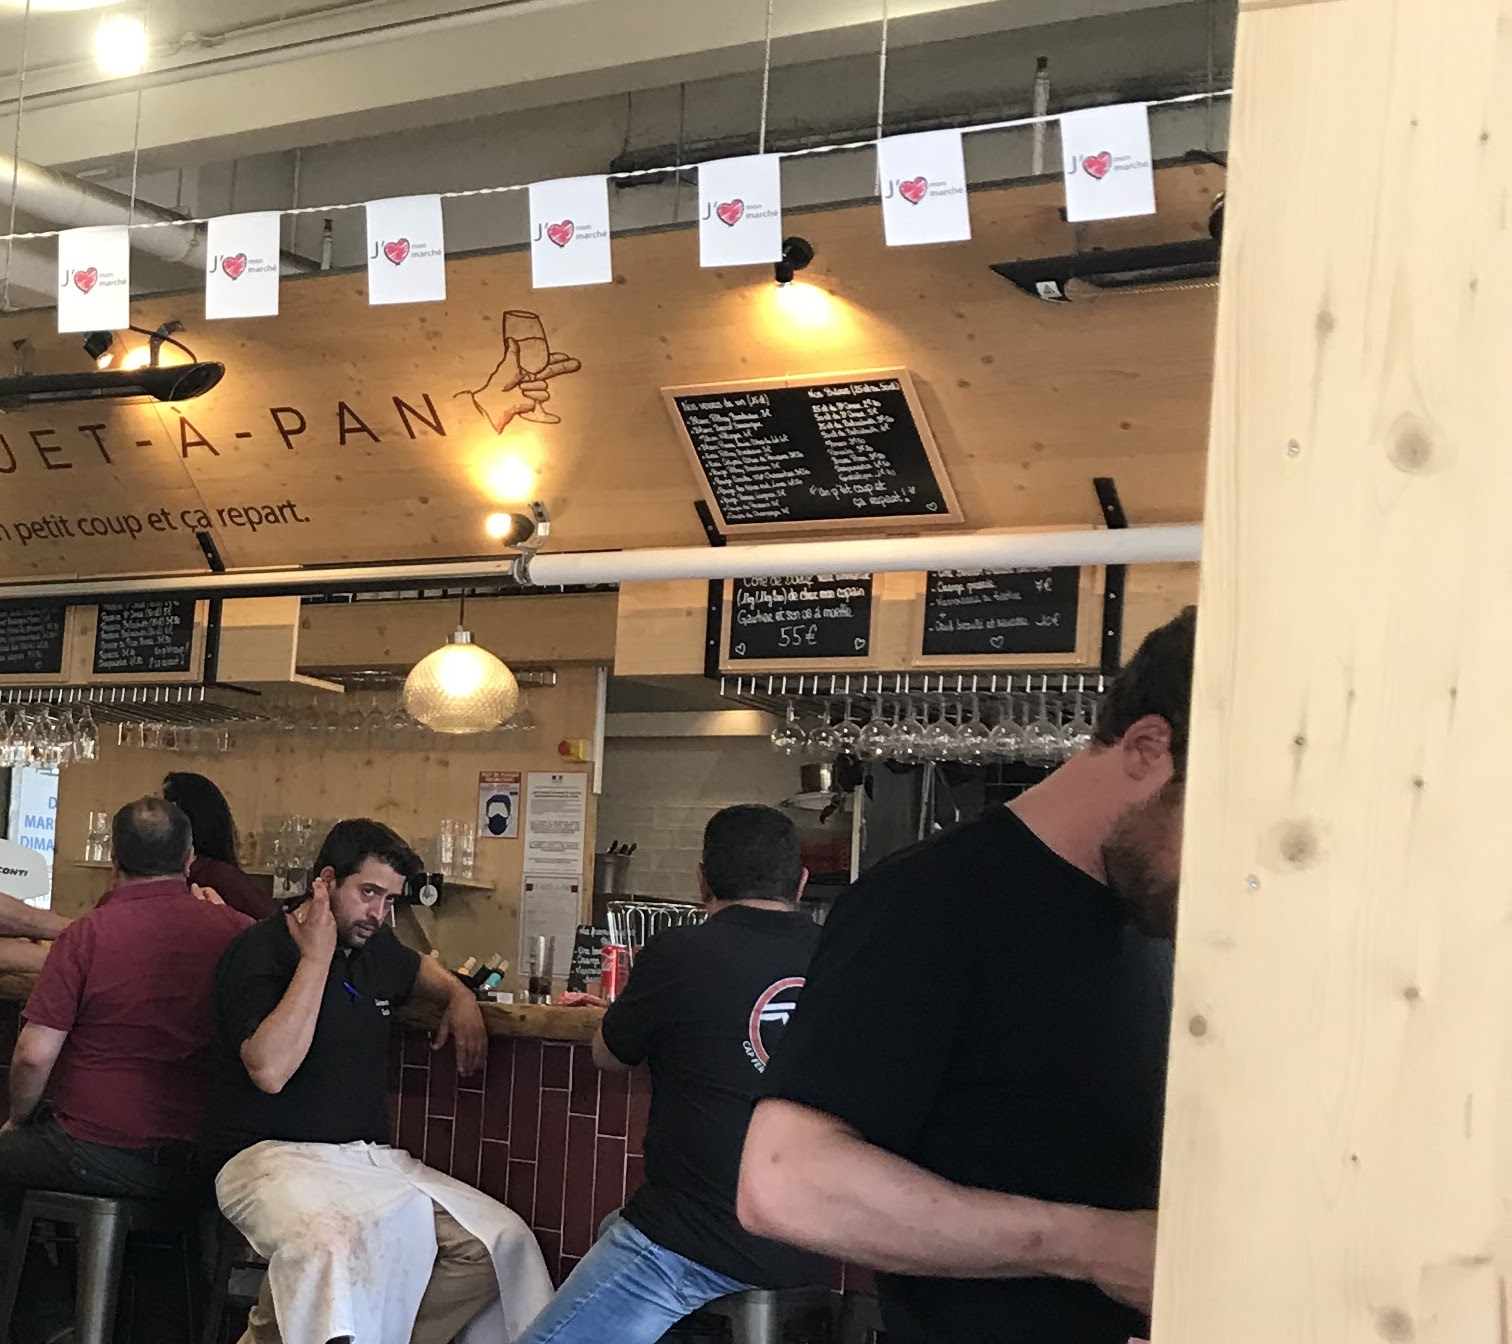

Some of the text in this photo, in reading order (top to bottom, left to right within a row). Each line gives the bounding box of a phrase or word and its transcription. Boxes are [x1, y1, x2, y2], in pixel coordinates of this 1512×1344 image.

[1068, 154, 1084, 175] J'
[885, 179, 900, 199] J'
[702, 201, 718, 220] J'
[534, 222, 548, 242] J'
[370, 240, 385, 259] J'
[411, 247, 442, 258] marché
[209, 255, 224, 273] J'
[248, 263, 277, 273] marché
[61, 269, 75, 287] J'
[99, 276, 127, 287] marché
[14, 514, 76, 546] petit
[78, 512, 143, 539] coup
[148, 507, 178, 532] et
[180, 509, 213, 534] ça
[217, 499, 311, 532] repart.
[777, 623, 818, 647] 55€
